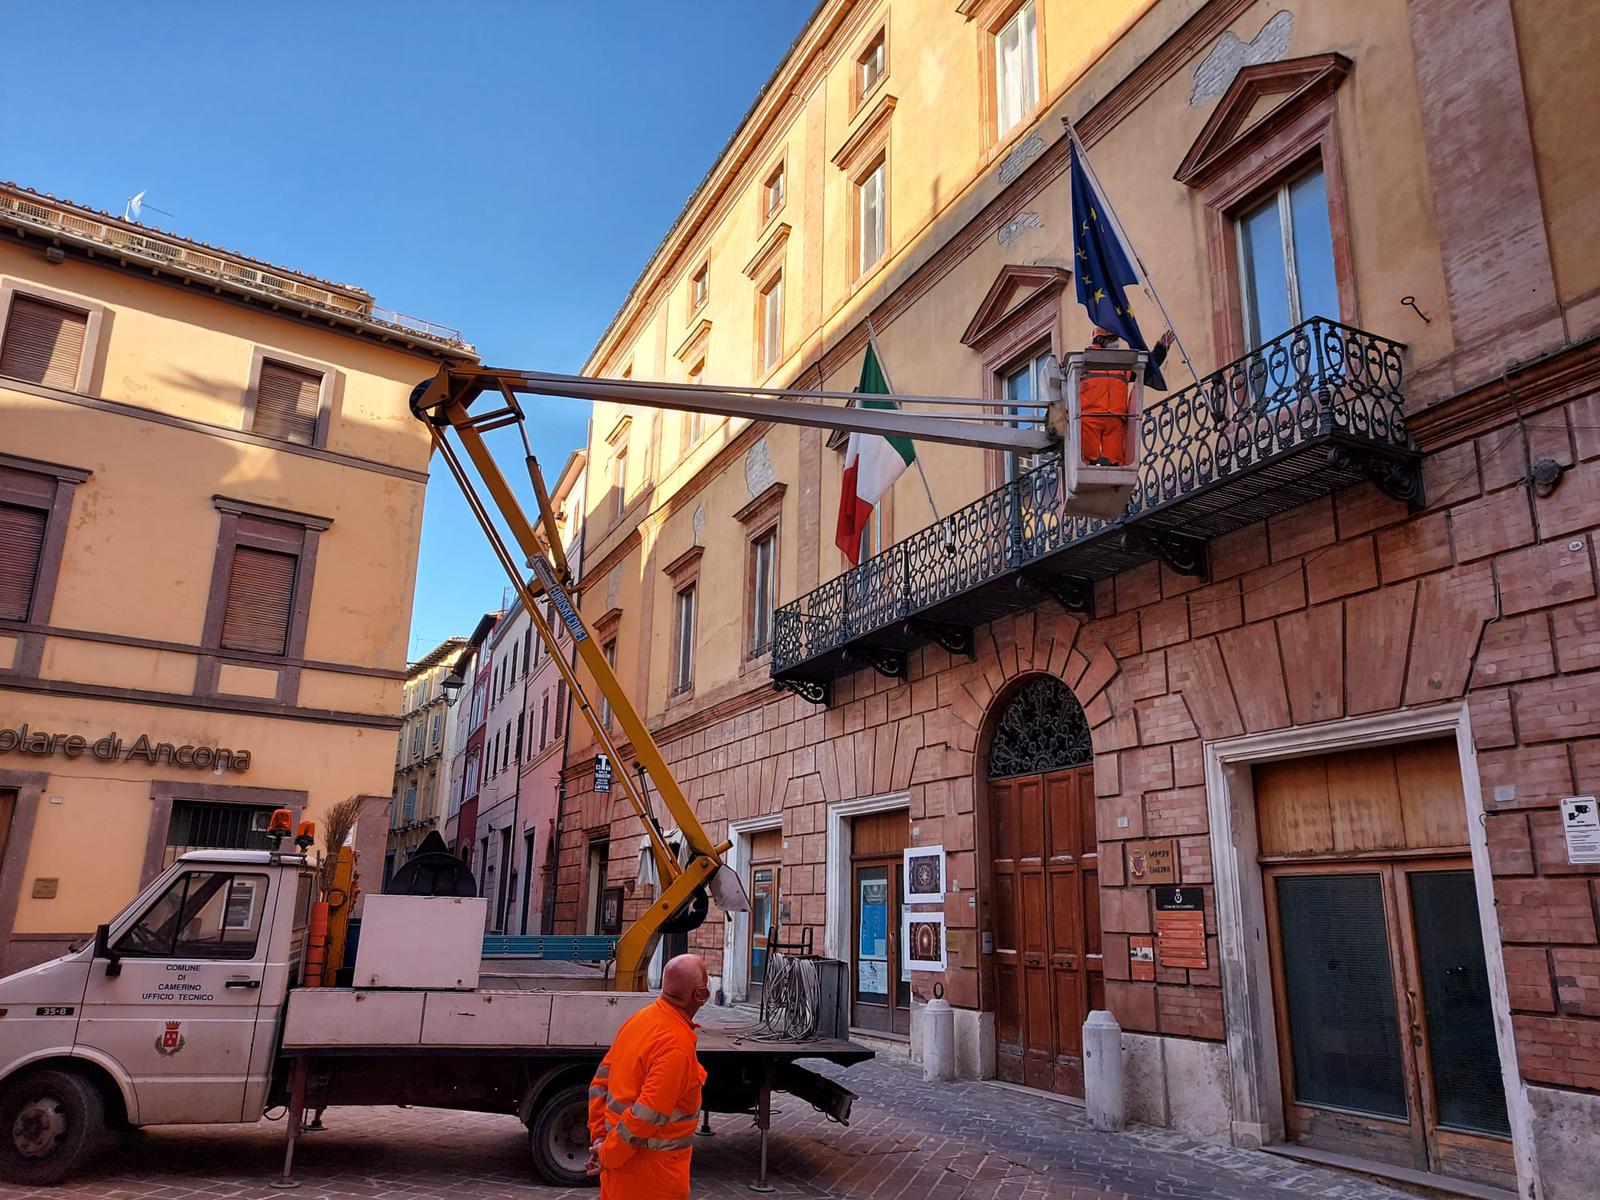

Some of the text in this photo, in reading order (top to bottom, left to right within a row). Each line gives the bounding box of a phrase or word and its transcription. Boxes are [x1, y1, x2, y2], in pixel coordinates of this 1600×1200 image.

[93, 732, 122, 760] di
[125, 733, 252, 771] Ancona
[166, 964, 201, 972] COMUNE
[158, 983, 202, 991] CAMERINO
[142, 993, 214, 1001] UFFICIO TECNICO
